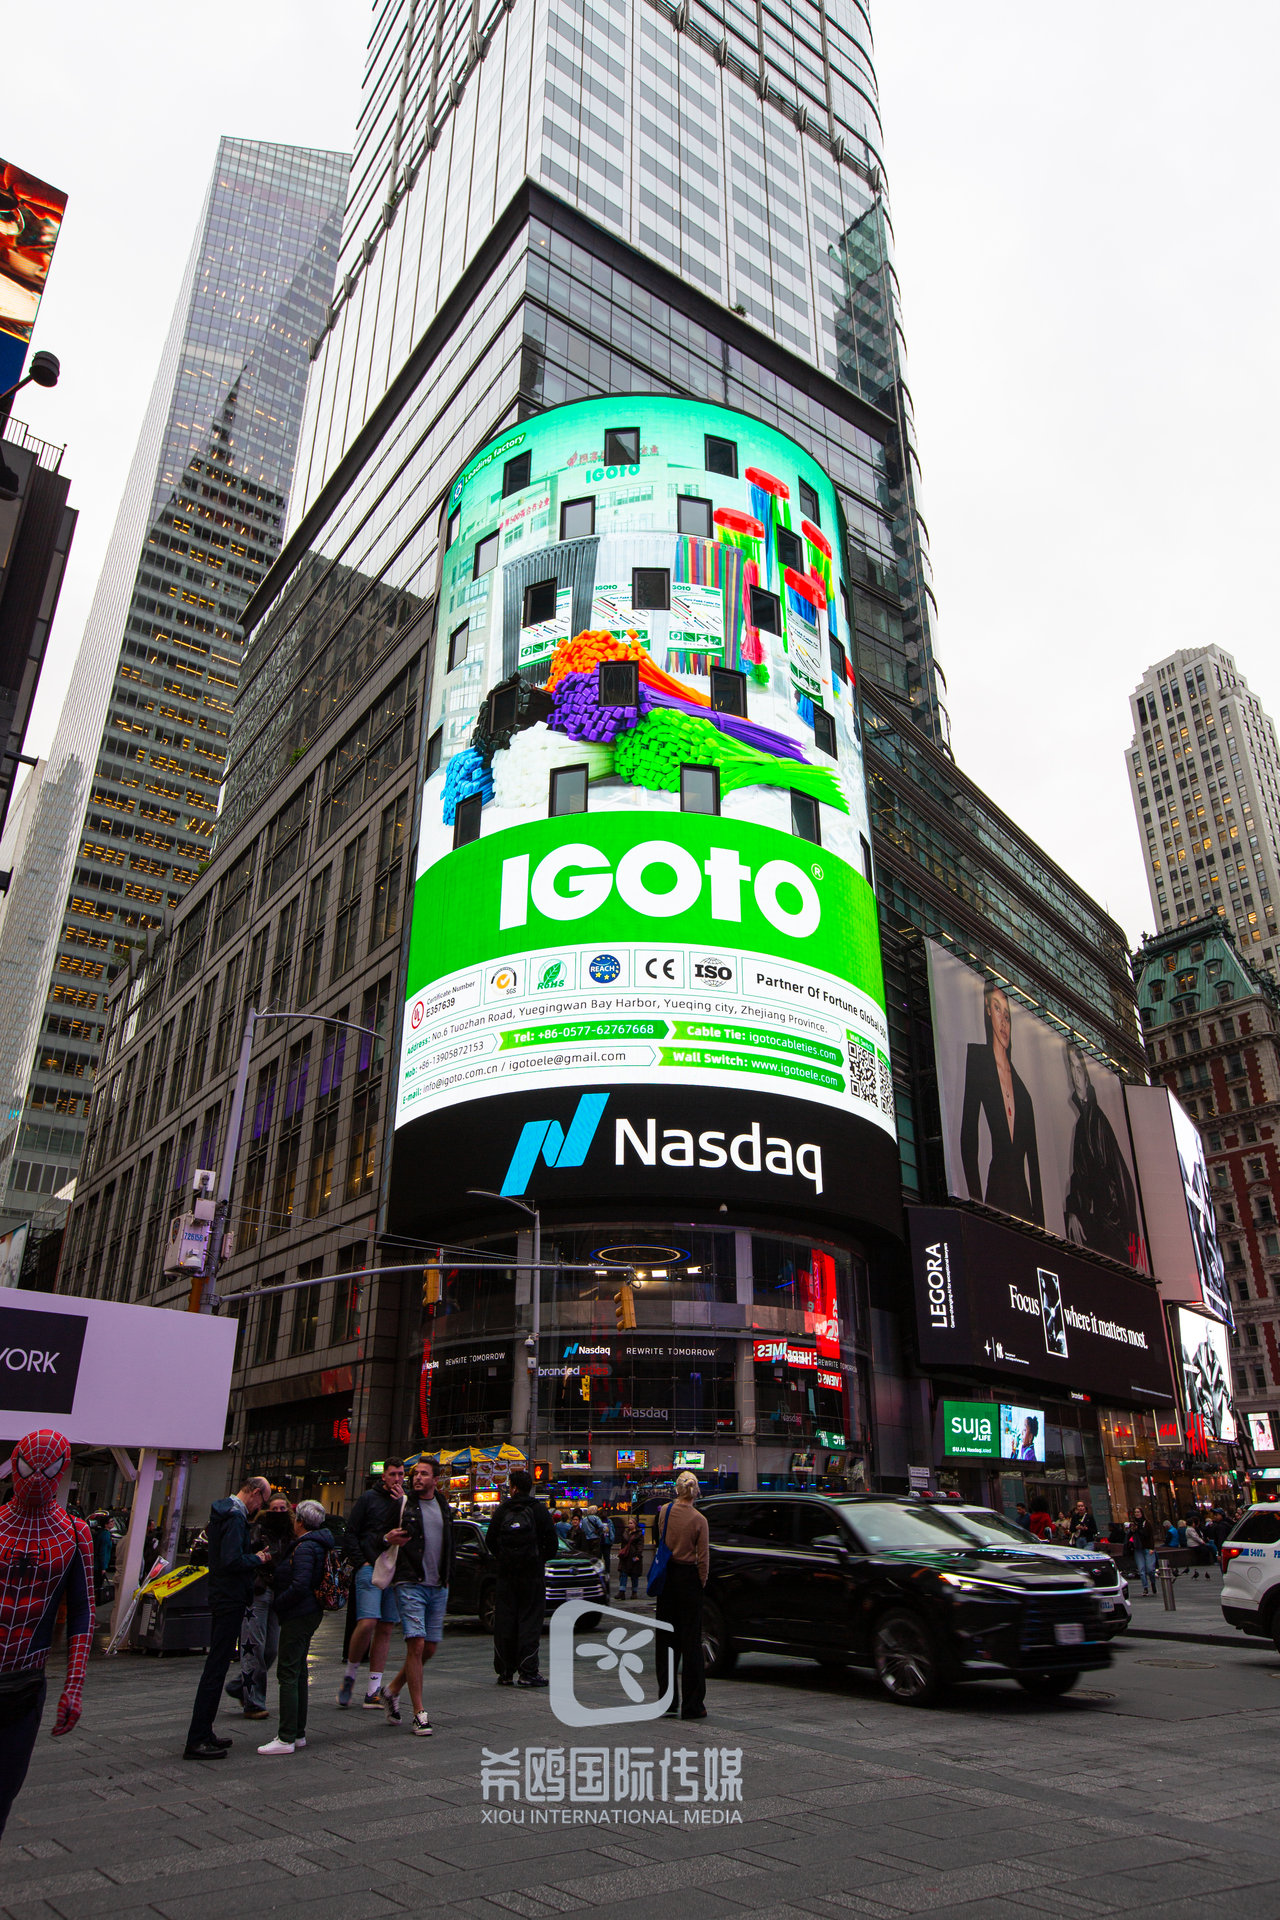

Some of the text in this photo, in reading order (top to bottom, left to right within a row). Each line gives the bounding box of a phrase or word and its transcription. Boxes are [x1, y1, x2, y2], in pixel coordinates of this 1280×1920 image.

[465, 434, 525, 483] Leading factory
[590, 965, 615, 973] REACH
[645, 958, 675, 980] CE
[694, 964, 733, 979] ISO
[426, 981, 476, 1006] Certificate Number
[506, 987, 517, 996] SGS
[756, 973, 804, 995] Partner
[807, 984, 820, 999] Of
[823, 991, 858, 1016] Fortune
[860, 1008, 880, 1032] Global
[426, 997, 456, 1018] E357639
[406, 1036, 431, 1056] Address:
[431, 1028, 448, 1041] No.6
[450, 1016, 486, 1034] Tuozhan
[488, 1008, 517, 1023] Road,
[591, 998, 612, 1011] Bay
[616, 998, 660, 1009] Harbor,
[664, 999, 712, 1012] Yueqing
[715, 1002, 737, 1015] city,
[741, 1005, 786, 1023] Zhejiang
[789, 1014, 828, 1034] Province.
[513, 1024, 654, 1043] Tel: +86-0577-62767668
[686, 1025, 837, 1061] Cable Tie: igotocableties.com
[404, 1041, 484, 1080] Mob: +86-13905872153
[673, 1051, 838, 1087] Wall Switch: www.igotoele.com
[402, 1087, 422, 1105] E-mail:
[422, 1064, 498, 1093] info@igoto.com.cn
[509, 1051, 626, 1071] igotoele@gmail.com
[615, 1118, 823, 1195] Nasdaq
[925, 1243, 948, 1328] LEGORA
[1009, 1284, 1149, 1349] Focus where it matters most.
[445, 1352, 506, 1366] REWRITE TOMORROW
[578, 1345, 611, 1356] Nasdaq
[626, 1347, 716, 1356] REWRITE TOMORROW
[537, 1364, 609, 1377] brandedcities
[818, 1358, 839, 1369] REWRITE
[623, 1407, 669, 1421] Nasdaq
[951, 1417, 992, 1441] suja
[978, 1434, 992, 1442] LIFE
